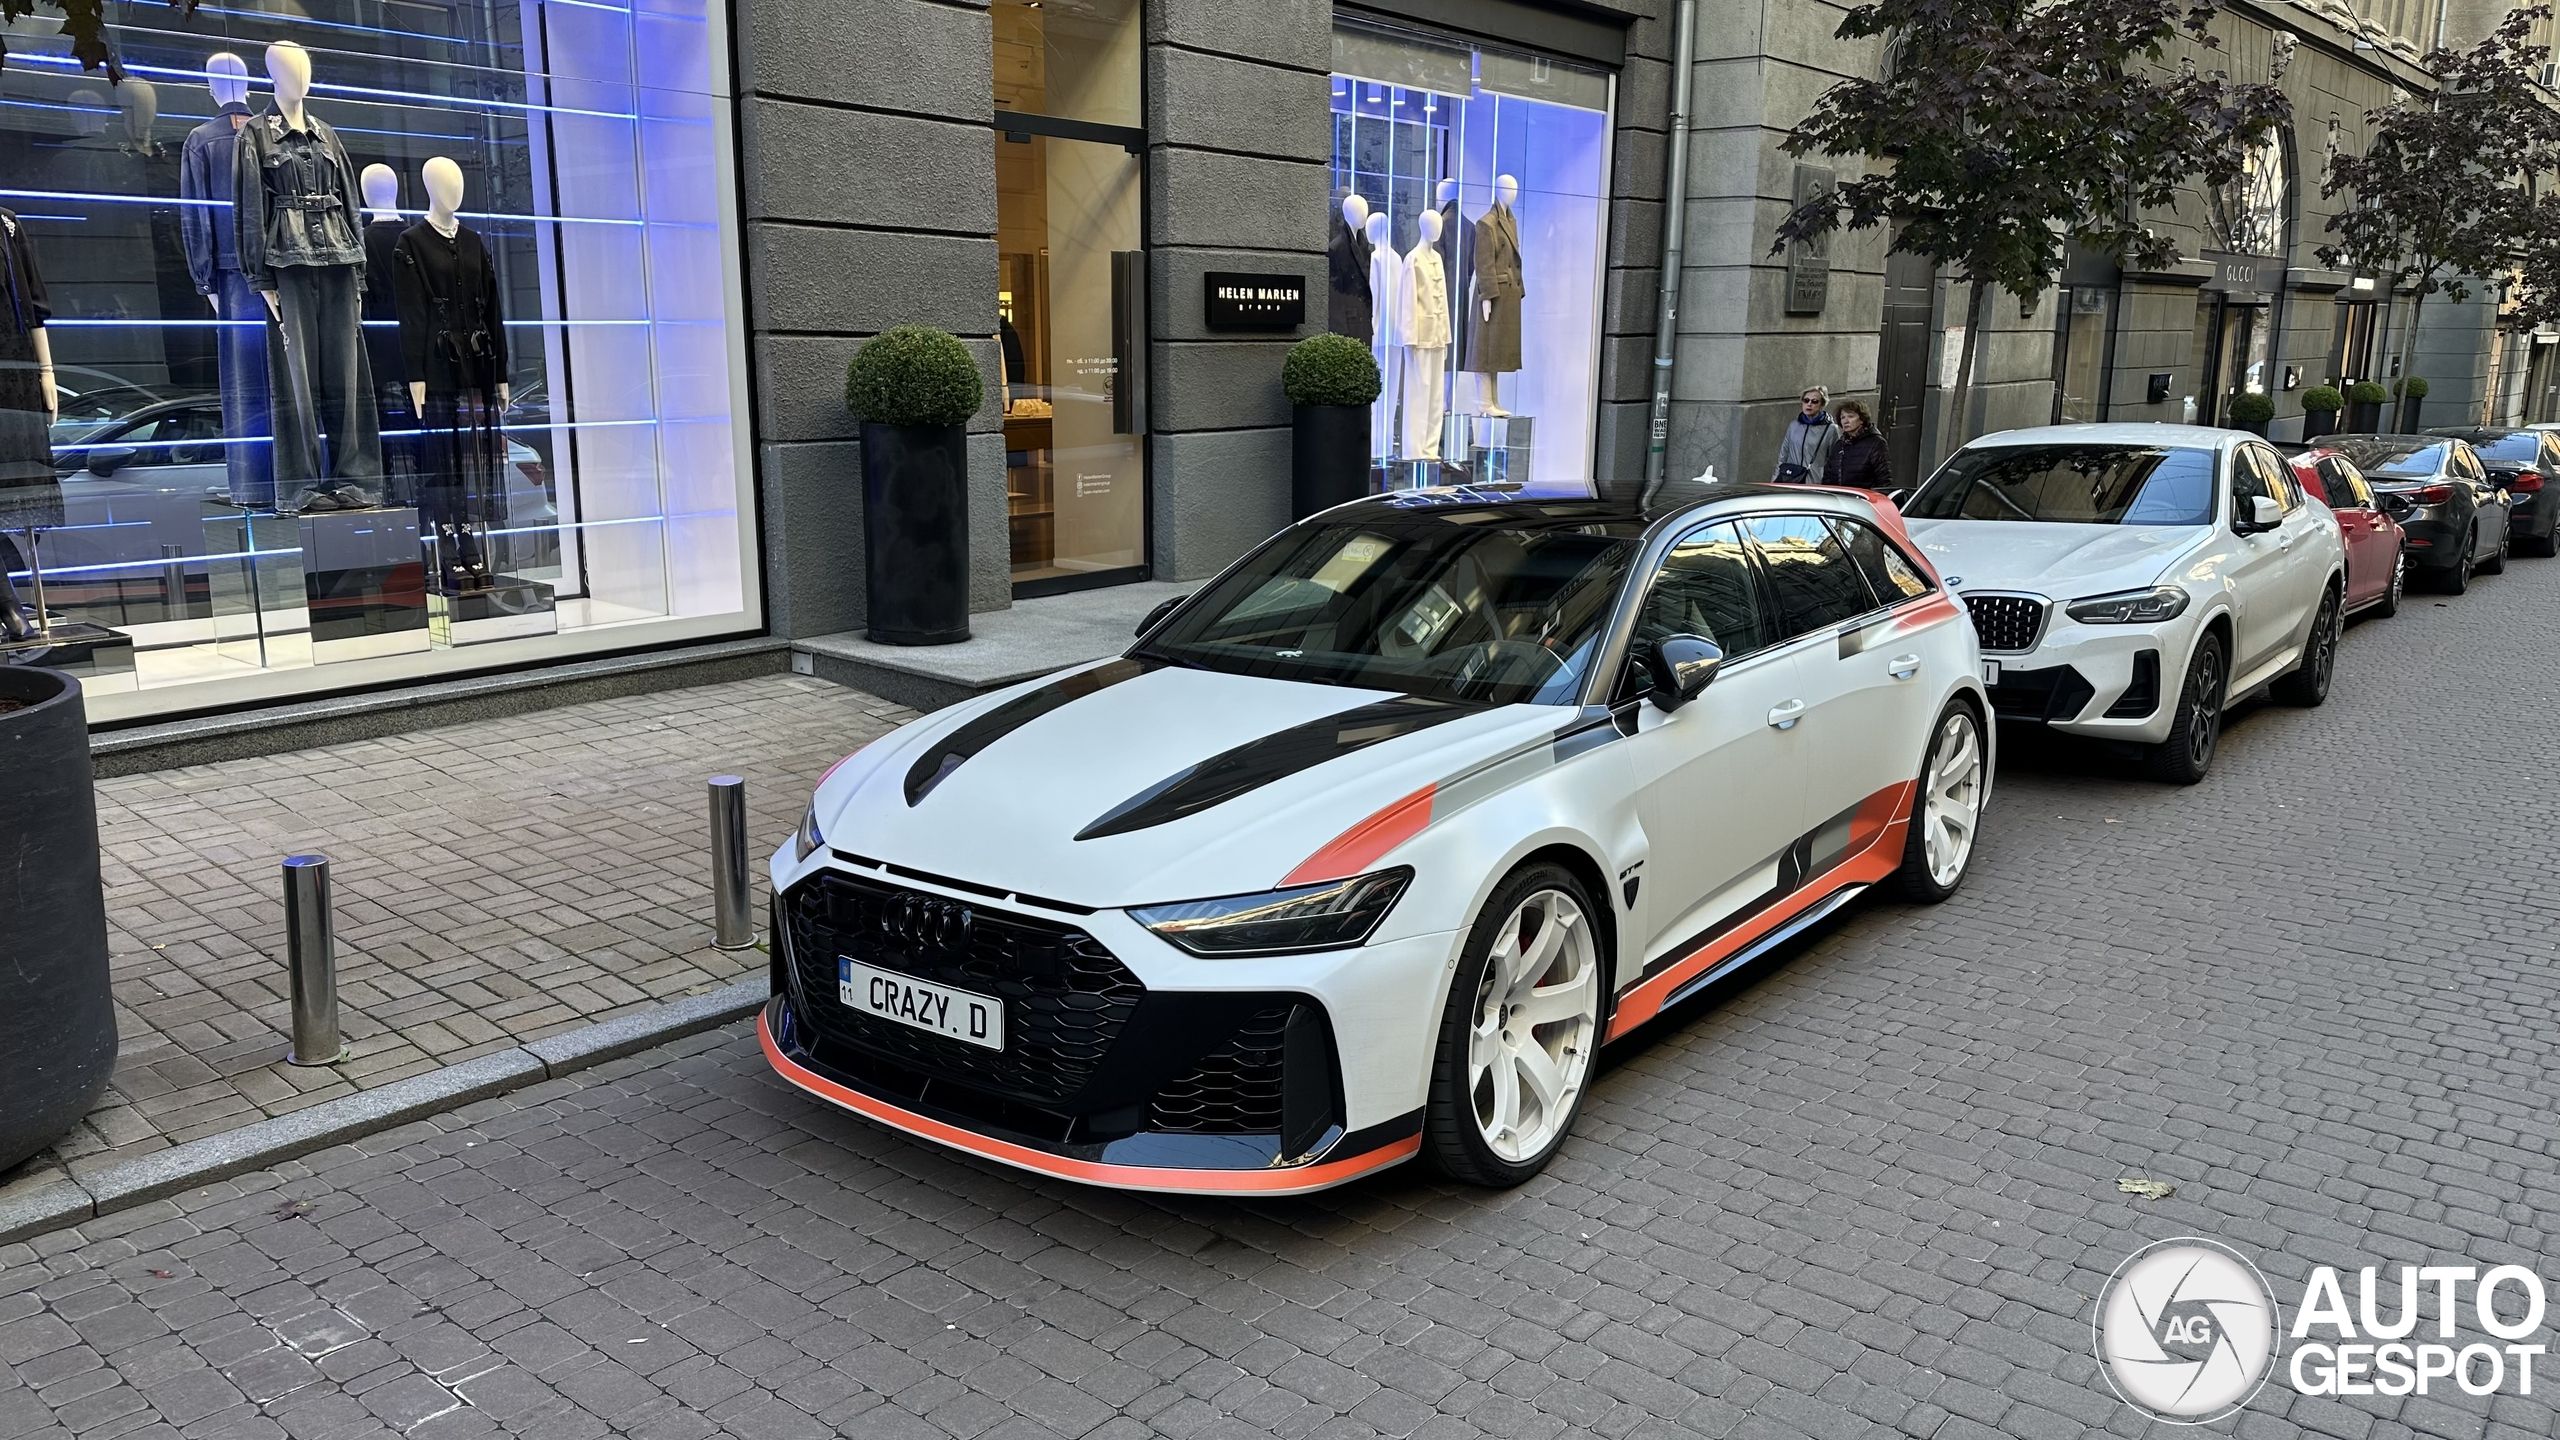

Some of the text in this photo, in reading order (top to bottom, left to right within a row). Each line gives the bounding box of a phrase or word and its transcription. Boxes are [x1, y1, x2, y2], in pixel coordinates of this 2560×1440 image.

[2226, 264, 2254, 282] GUCCI
[1218, 286, 1299, 300] HELEN MARLEN
[1654, 420, 1667, 428] BNE
[841, 985, 853, 1002] 11
[969, 1002, 987, 1039] D
